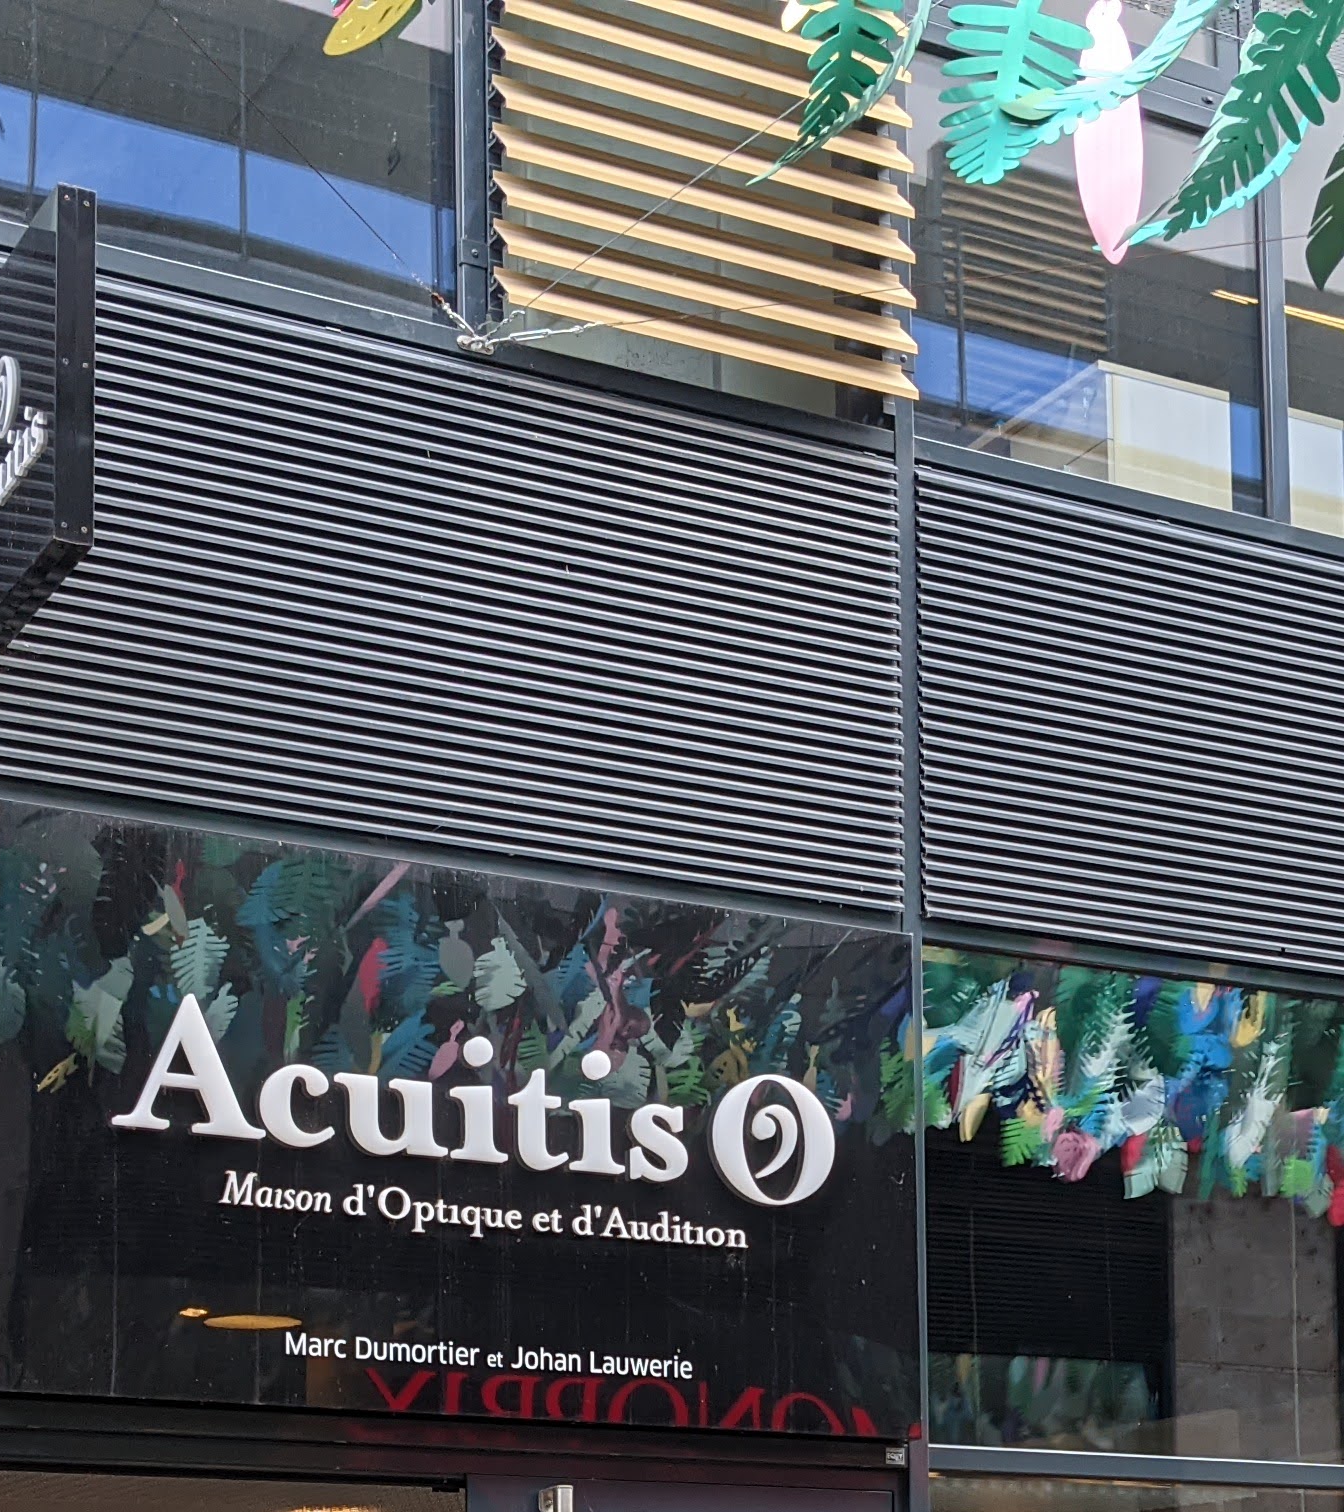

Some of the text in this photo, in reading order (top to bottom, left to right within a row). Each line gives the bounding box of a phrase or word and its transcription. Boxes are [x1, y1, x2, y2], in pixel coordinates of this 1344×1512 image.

[111, 993, 689, 1183] Acuitis
[219, 1171, 749, 1249] Maison d'Optique et d'Audition
[285, 1331, 694, 1382] Marc Dumortier et Johan Lauwerie
